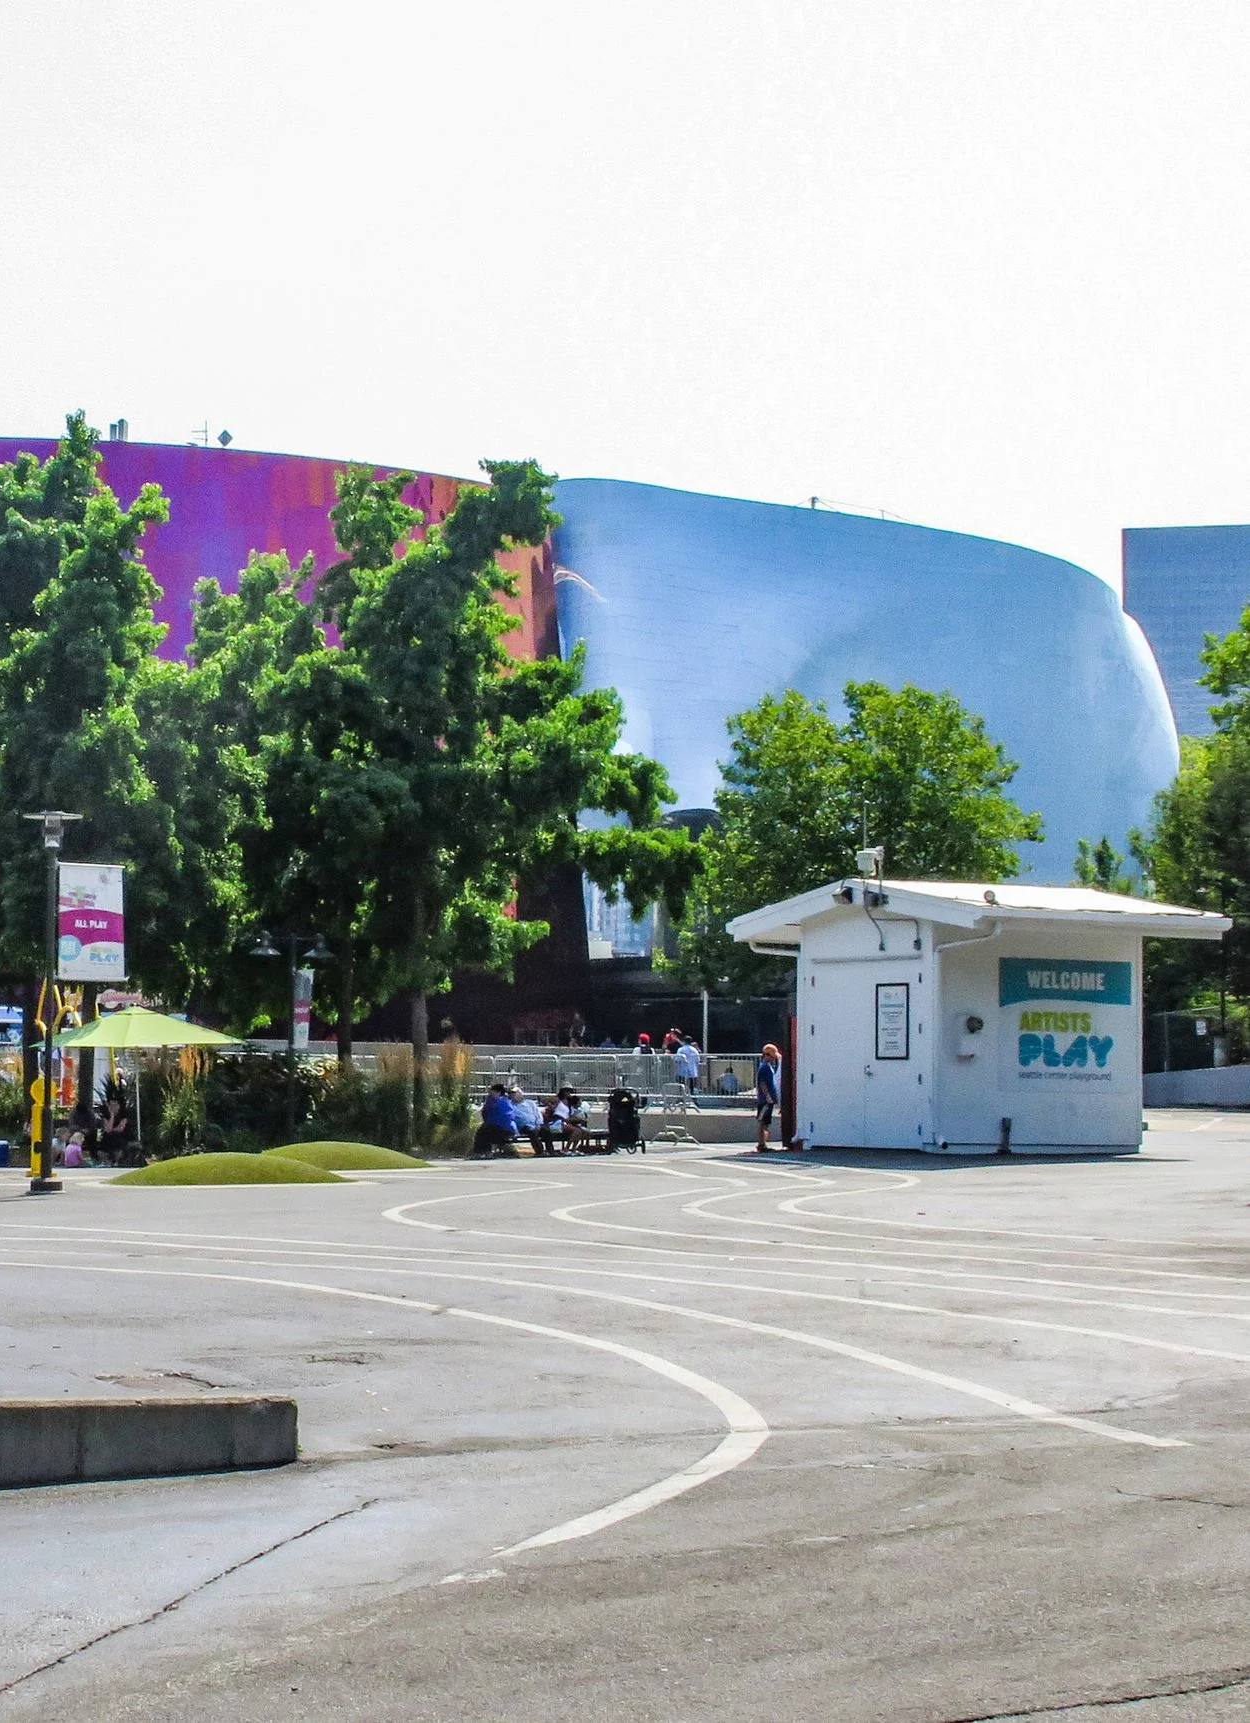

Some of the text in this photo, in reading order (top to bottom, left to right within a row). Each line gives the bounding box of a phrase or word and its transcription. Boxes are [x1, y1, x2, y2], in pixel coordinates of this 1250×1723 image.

[74, 919, 108, 929] ALL PLAY
[1027, 971, 1105, 991] WELCOME
[1020, 1011, 1091, 1033] ARTISTS
[1018, 1033, 1114, 1068] PLAY
[1043, 1071, 1067, 1081] center
[1069, 1072, 1112, 1082] playground
